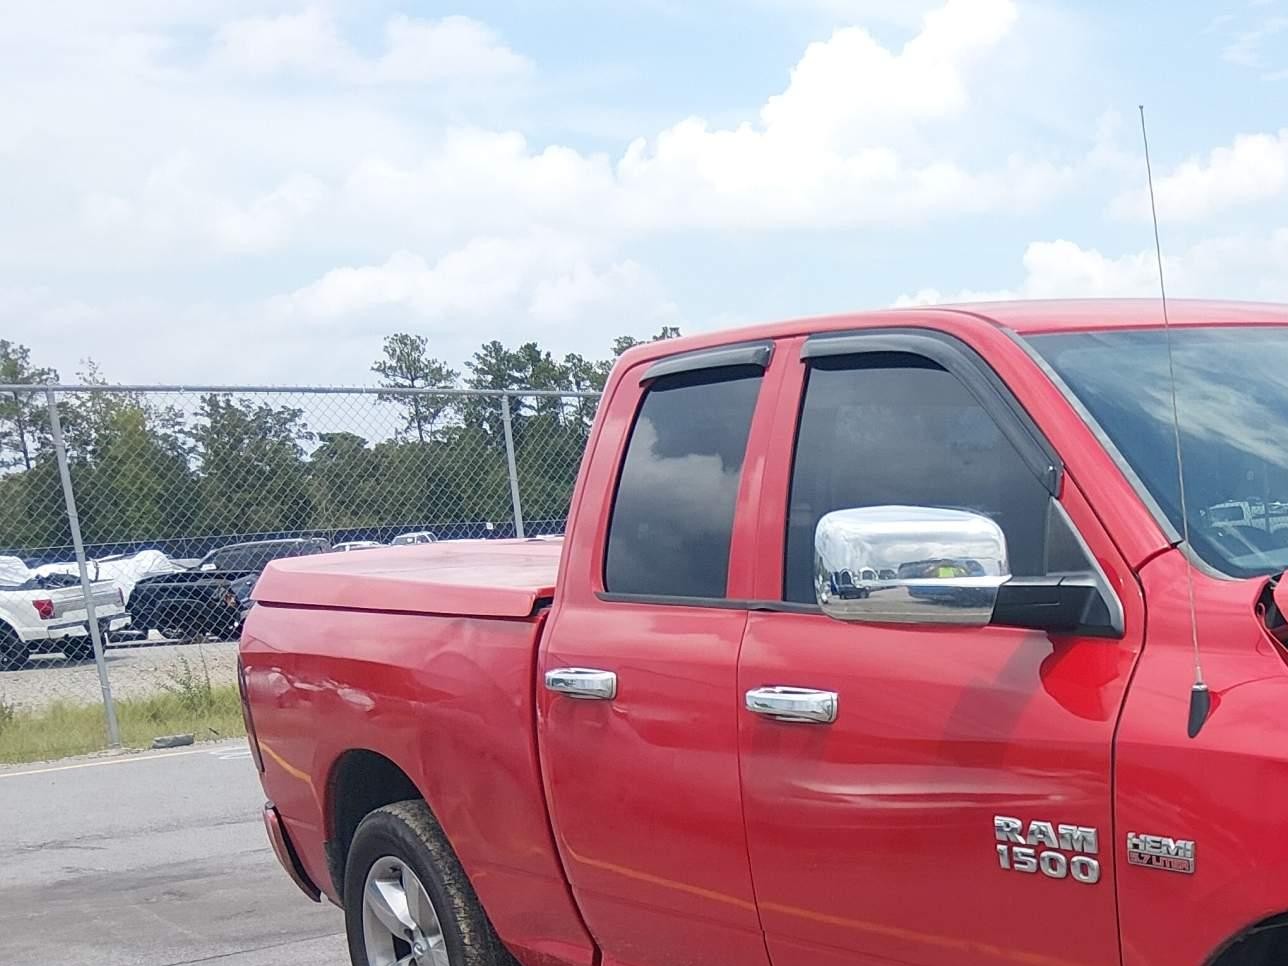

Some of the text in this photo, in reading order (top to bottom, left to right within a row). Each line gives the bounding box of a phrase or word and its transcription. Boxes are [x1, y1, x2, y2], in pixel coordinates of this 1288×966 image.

[994, 815, 1099, 855] RAM
[1127, 832, 1195, 858] HEMI
[995, 844, 1101, 884] 1500
